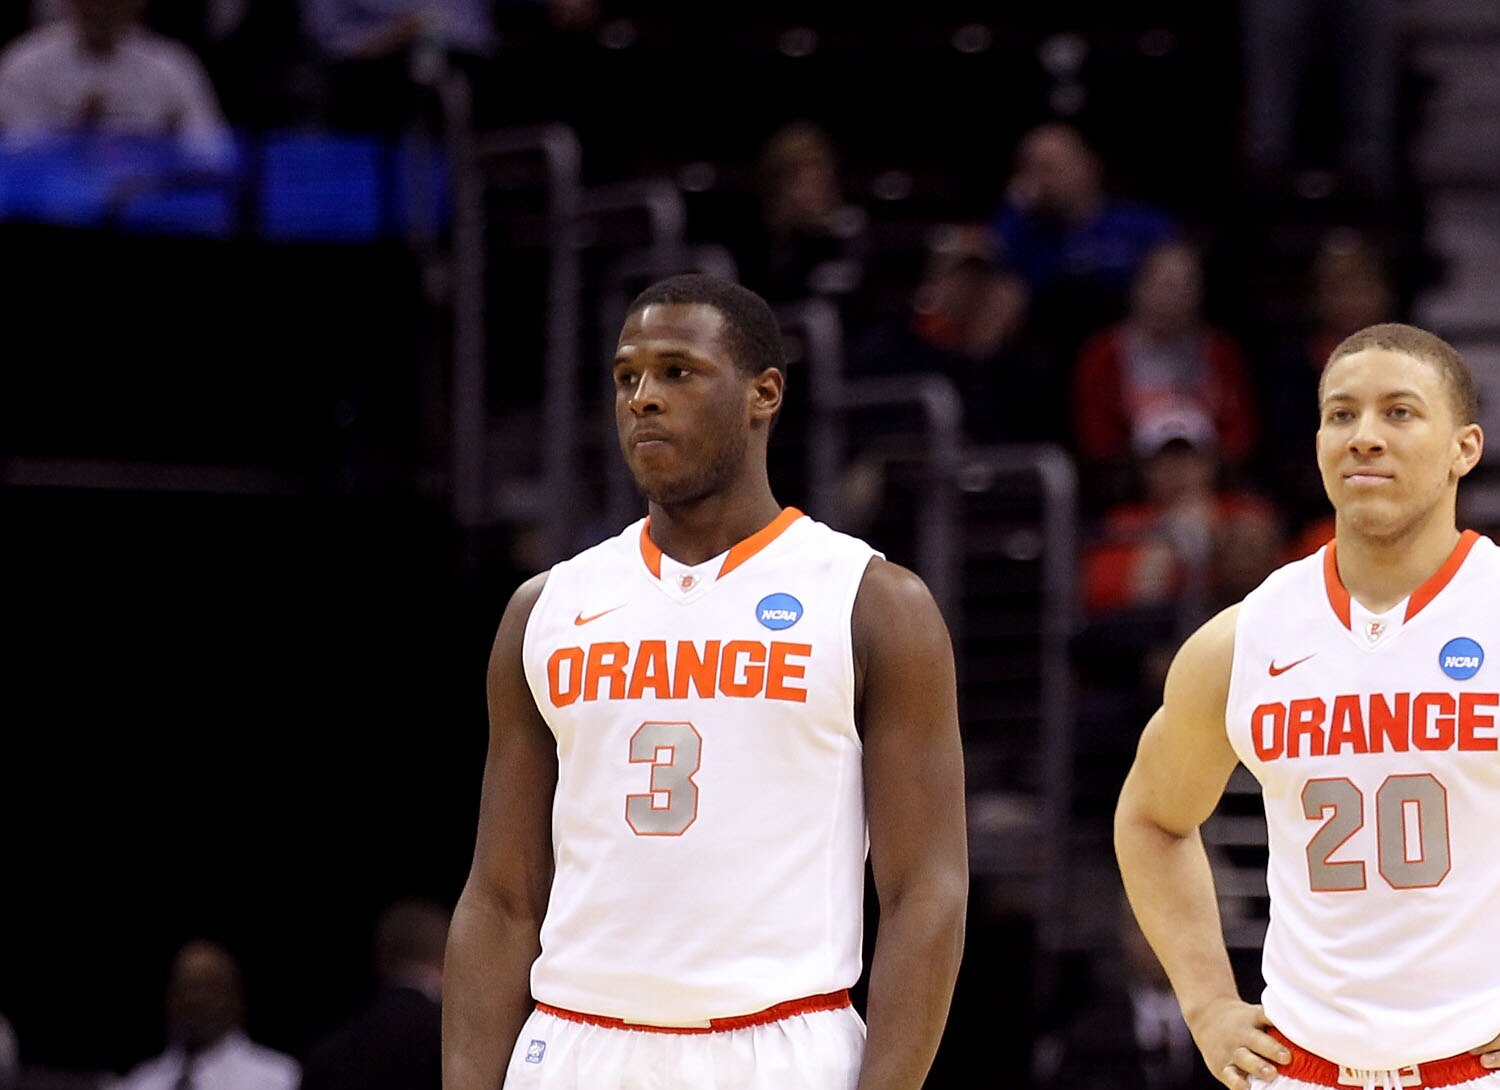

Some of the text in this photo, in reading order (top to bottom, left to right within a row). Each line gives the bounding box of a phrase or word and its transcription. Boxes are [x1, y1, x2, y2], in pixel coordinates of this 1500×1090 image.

[761, 609, 798, 622] NCAA
[547, 640, 812, 709] ORANGE
[1444, 656, 1479, 668] NCAA
[1251, 692, 1500, 762] ORANGE
[625, 721, 702, 836] 3
[1301, 773, 1451, 892] 20
